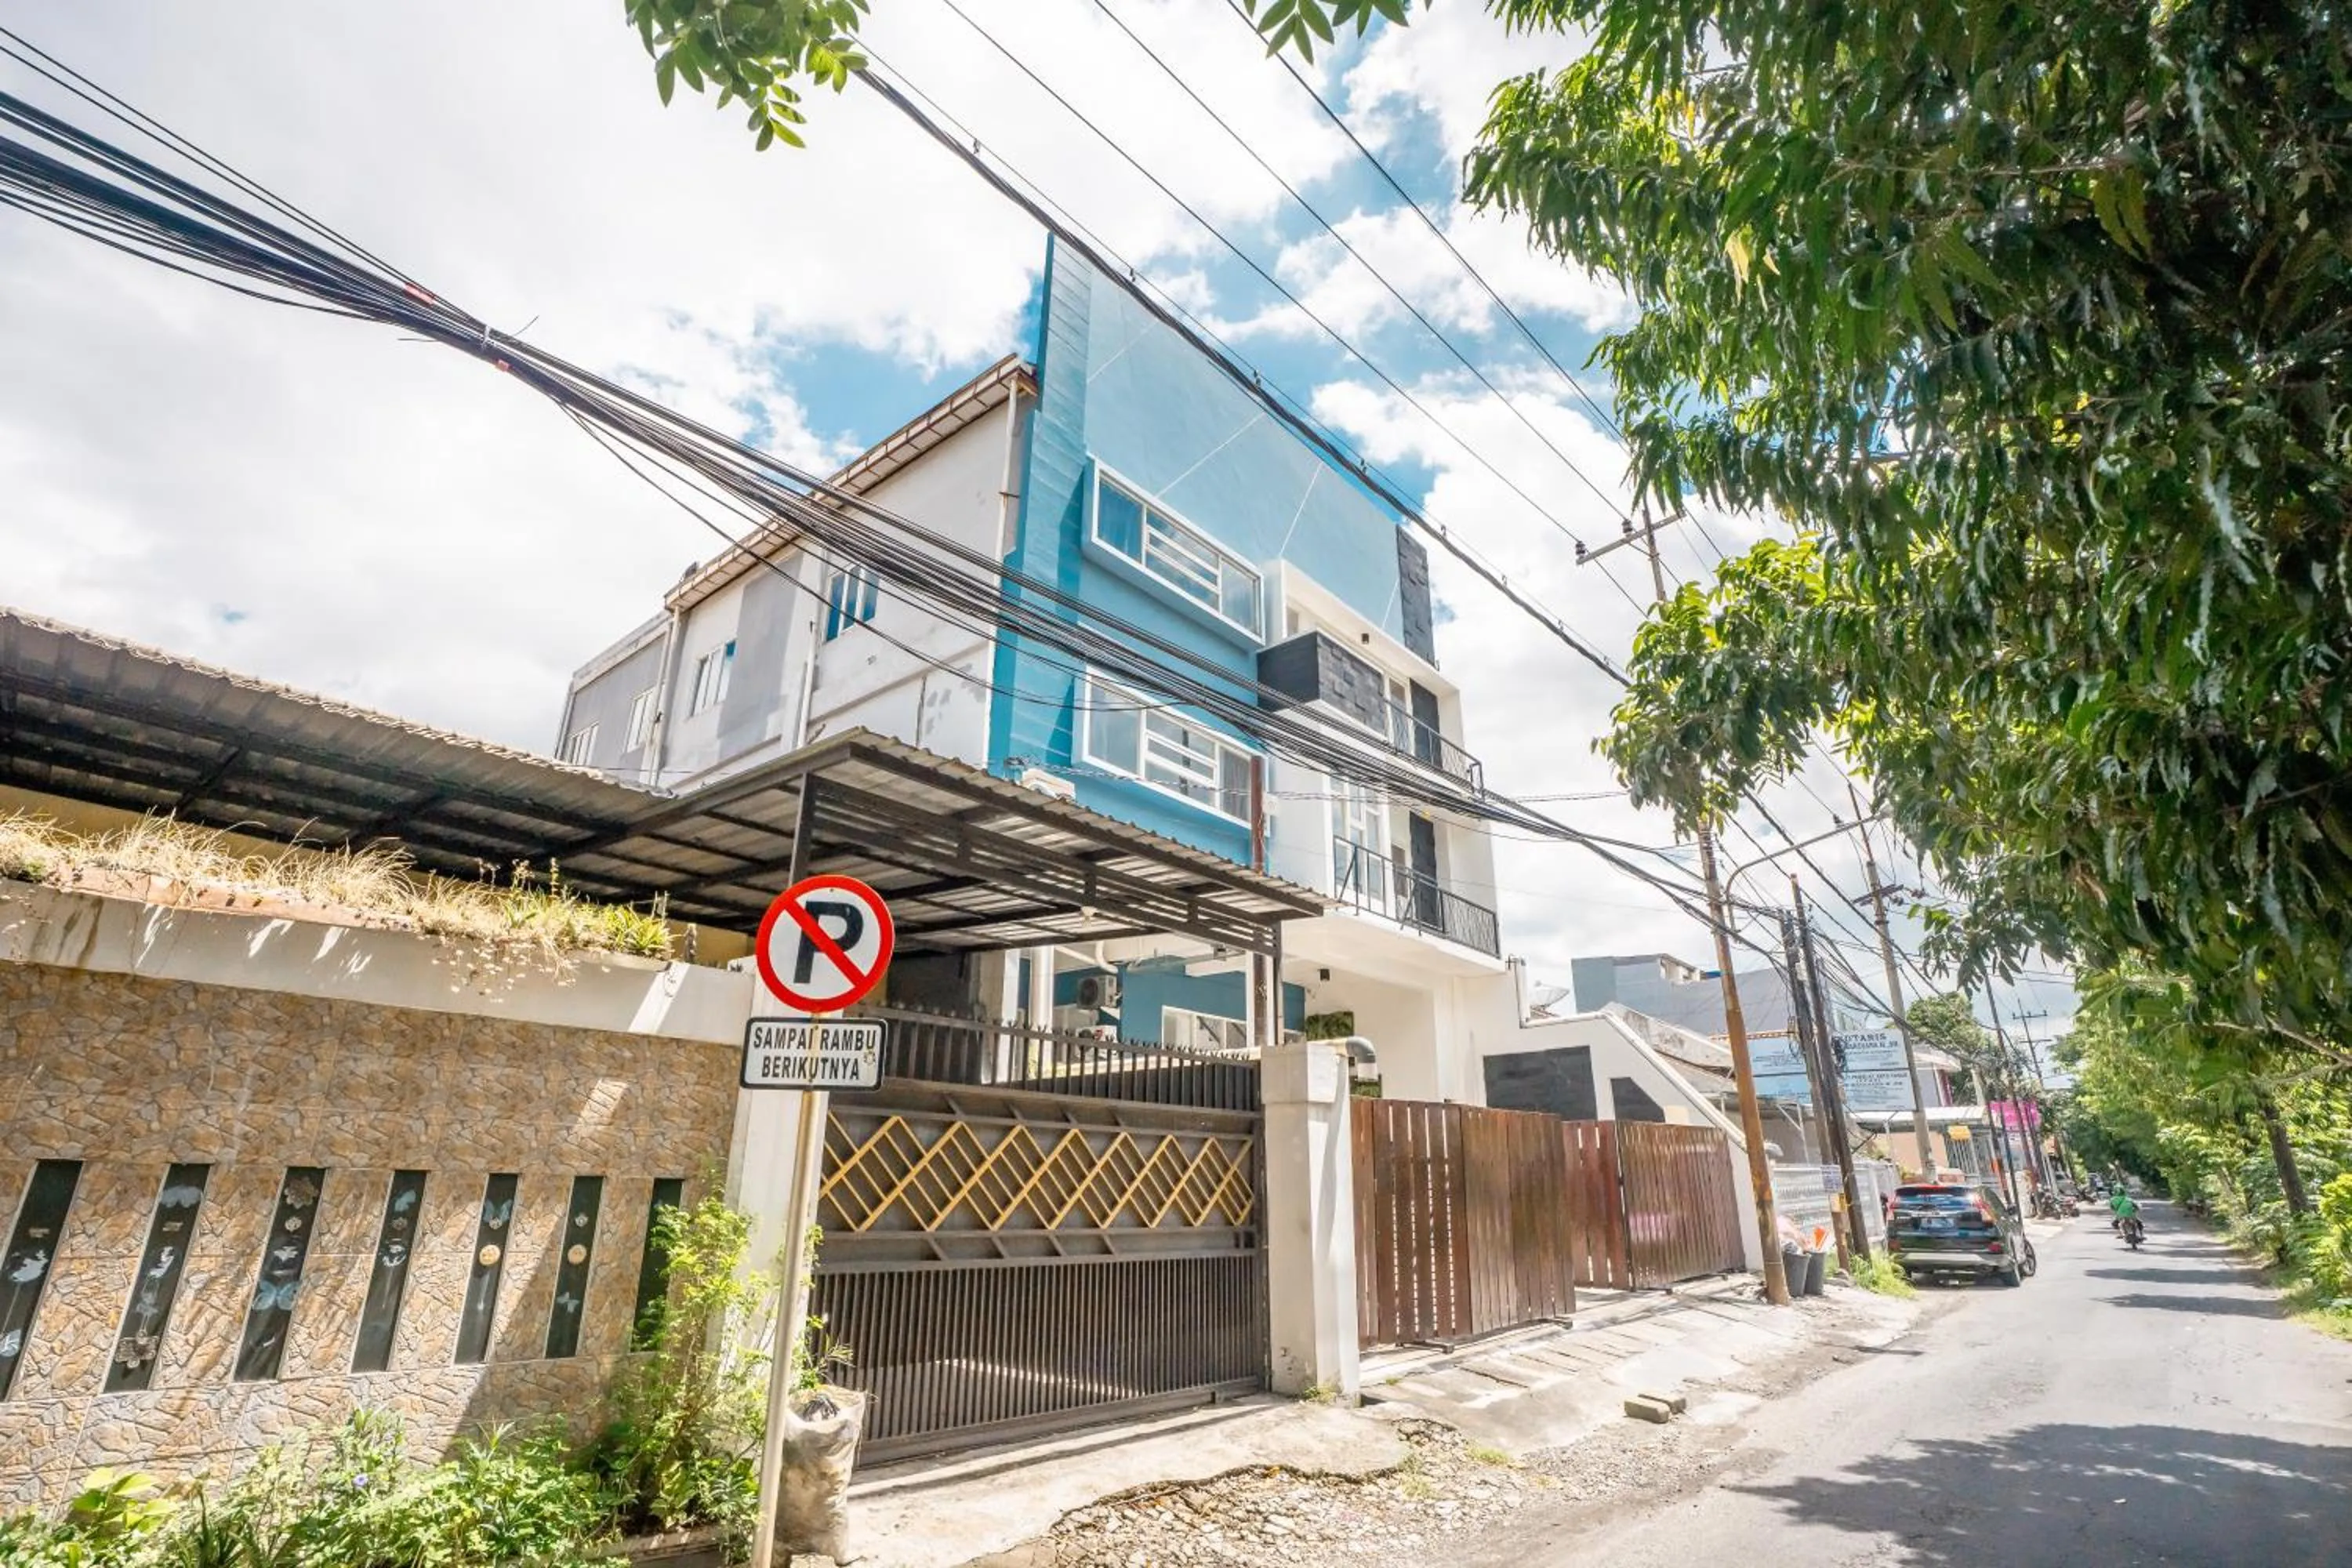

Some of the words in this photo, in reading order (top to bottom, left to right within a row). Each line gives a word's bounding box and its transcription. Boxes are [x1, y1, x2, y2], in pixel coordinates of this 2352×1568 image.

[793, 901, 863, 984] P
[753, 1026, 814, 1051] SAMPAI
[819, 1027, 877, 1051] RAMBU
[761, 1055, 860, 1080] BERIKUTNYA
